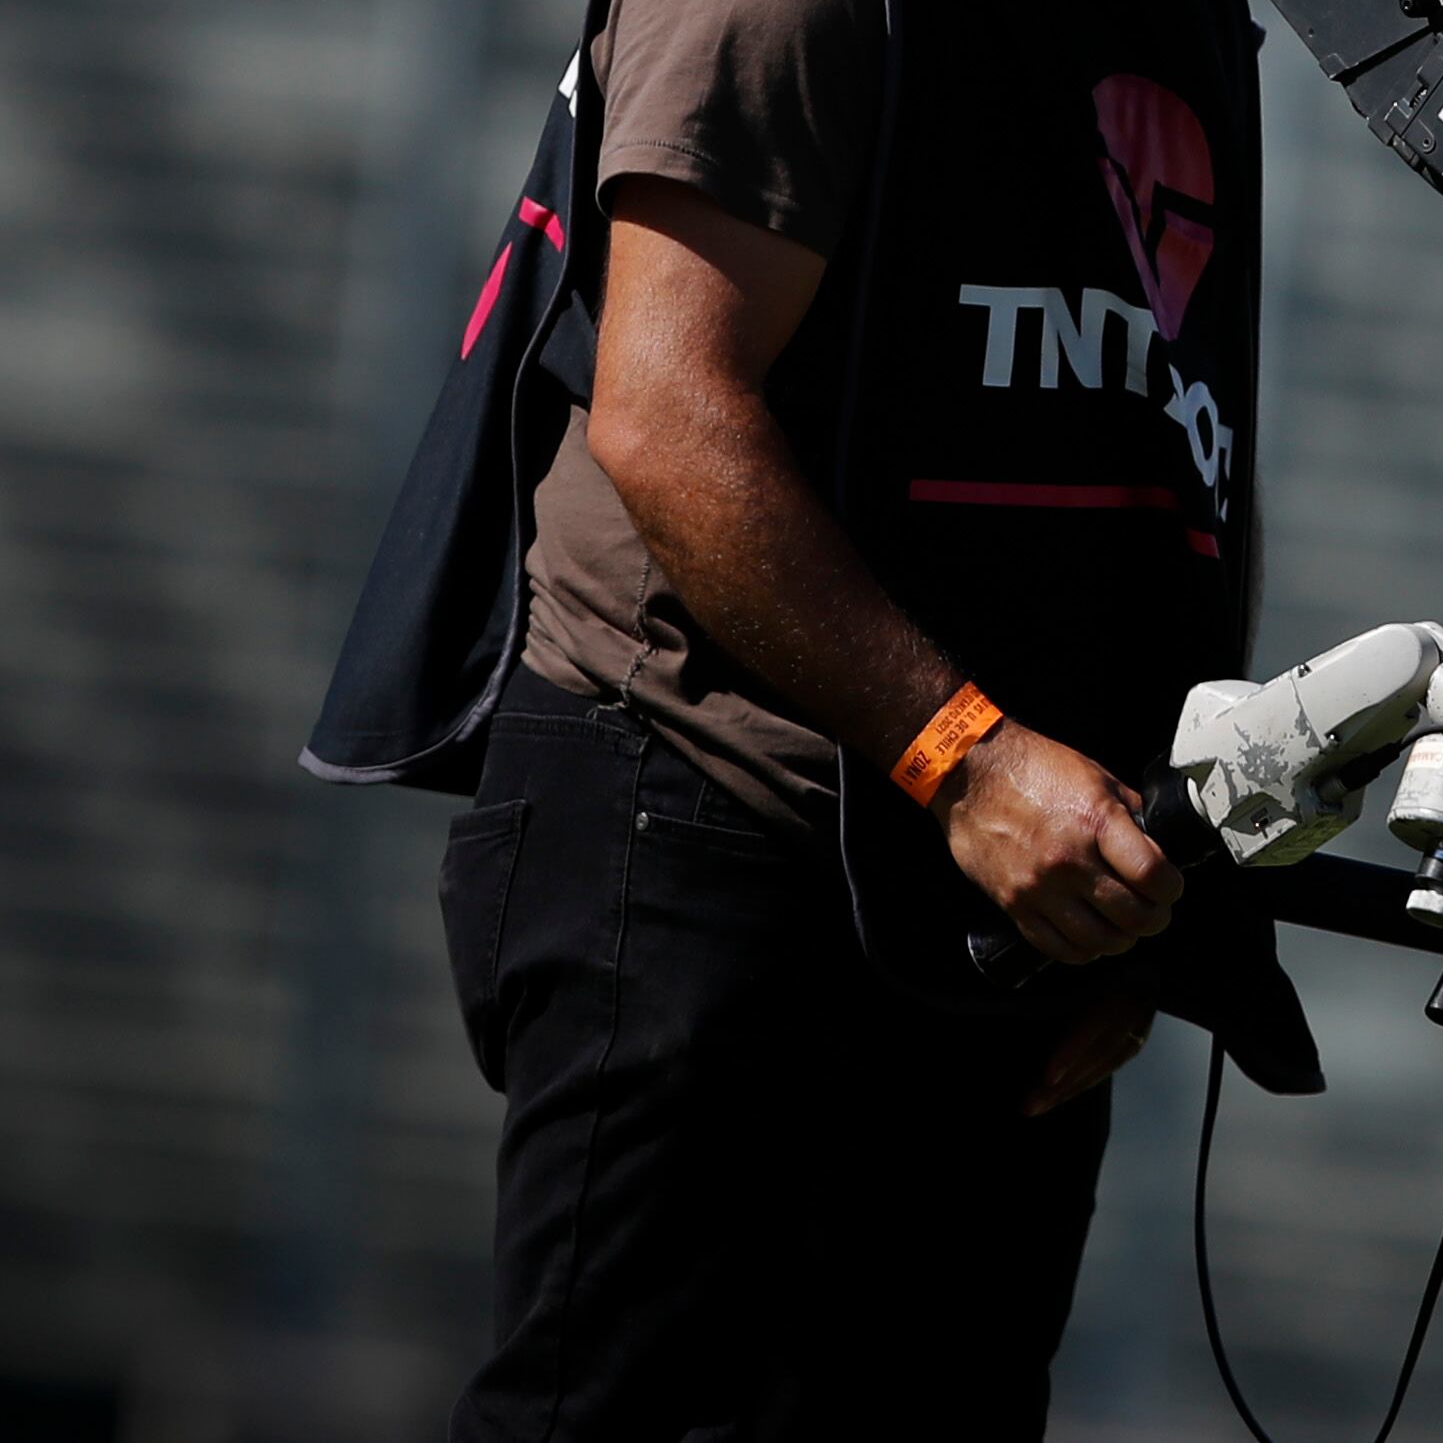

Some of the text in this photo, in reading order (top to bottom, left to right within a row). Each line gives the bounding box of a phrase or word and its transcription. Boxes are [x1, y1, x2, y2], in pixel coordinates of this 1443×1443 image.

[958, 284, 1159, 398] TNT
[934, 730, 959, 755] CHILE
[906, 749, 931, 779] ZONA
